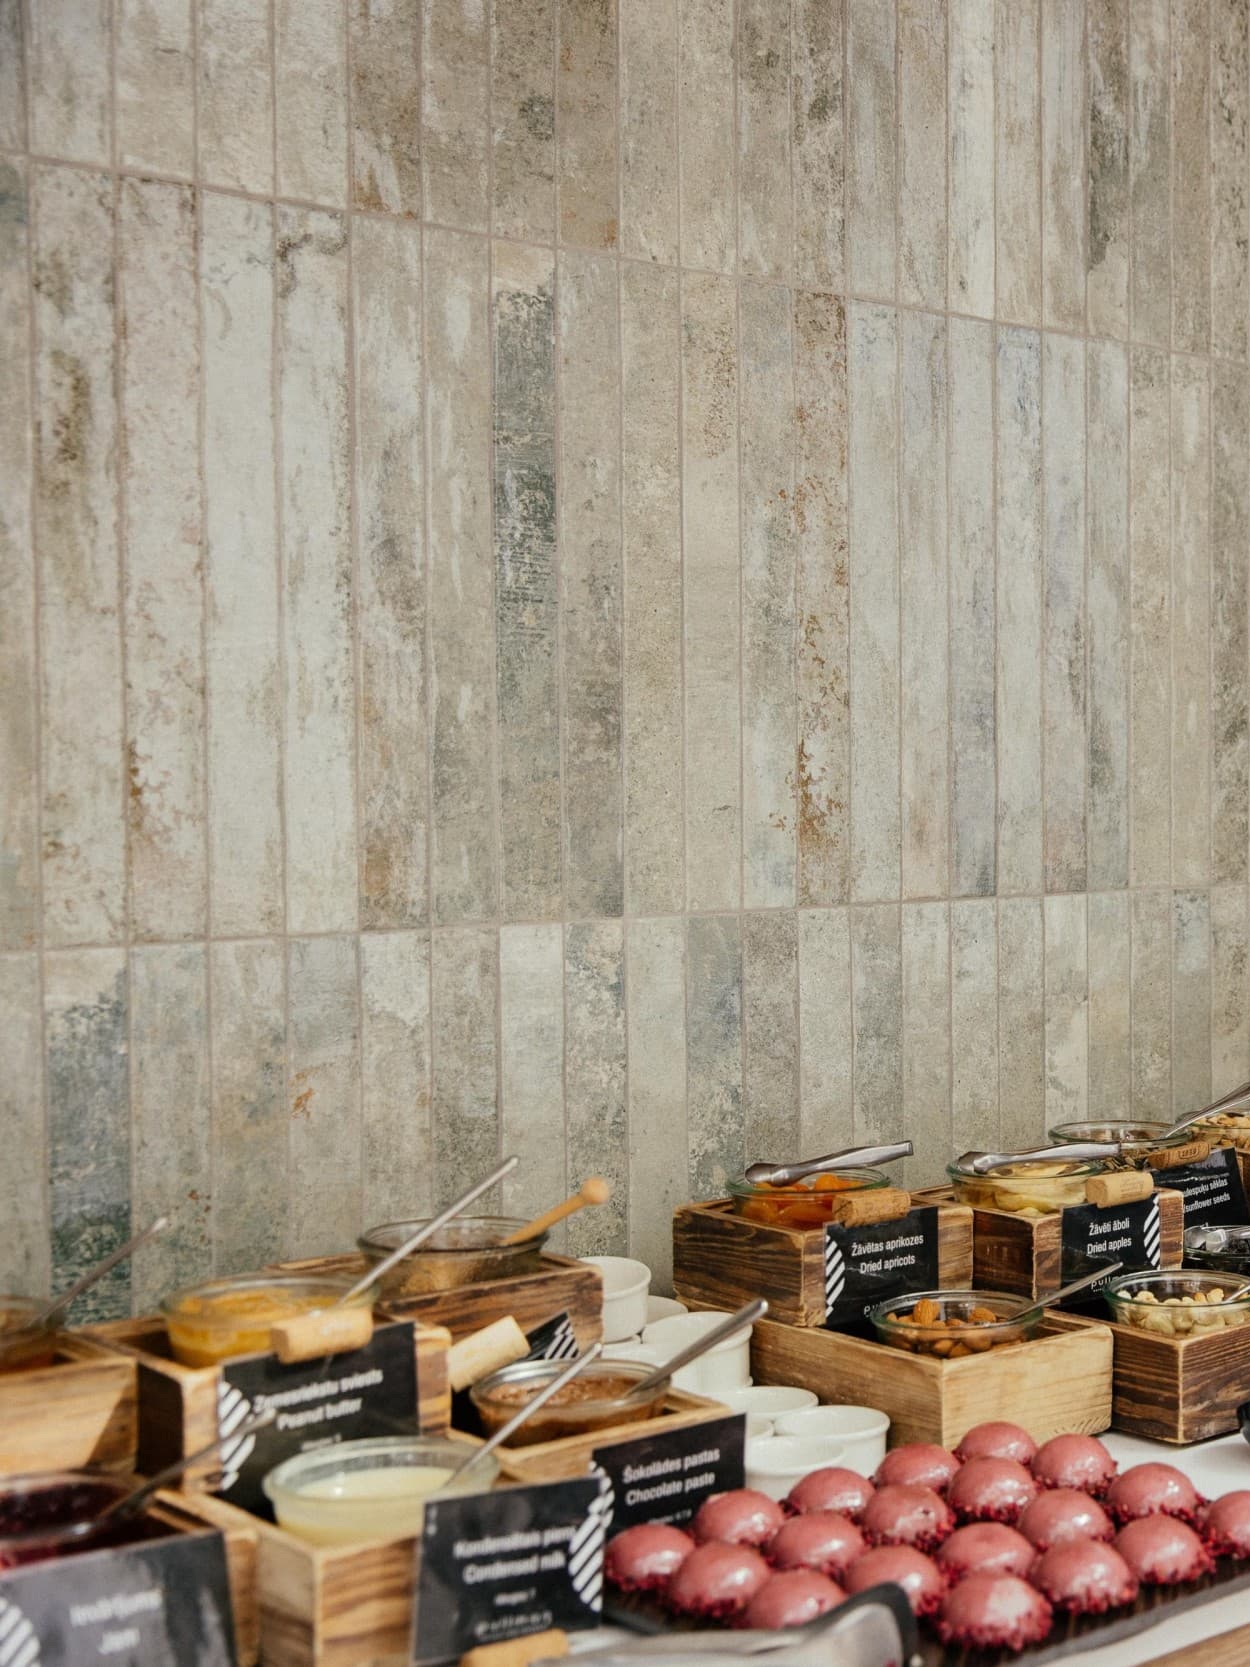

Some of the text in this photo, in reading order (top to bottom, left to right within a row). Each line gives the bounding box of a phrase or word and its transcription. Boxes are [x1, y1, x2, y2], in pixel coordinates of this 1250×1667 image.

[1213, 1192, 1231, 1205] seeds
[1088, 1217, 1130, 1236] Žāvēti āboli
[851, 1234, 924, 1257] Žāvētas aprikozes
[1087, 1236, 1132, 1255] Dried apples
[860, 1254, 916, 1274] Dried apricots
[276, 1397, 363, 1431] Peanut butter
[623, 1448, 720, 1484] Šokolādes pastas
[625, 1472, 716, 1506] Chocolate paste
[462, 1550, 566, 1584] Condensed milk
